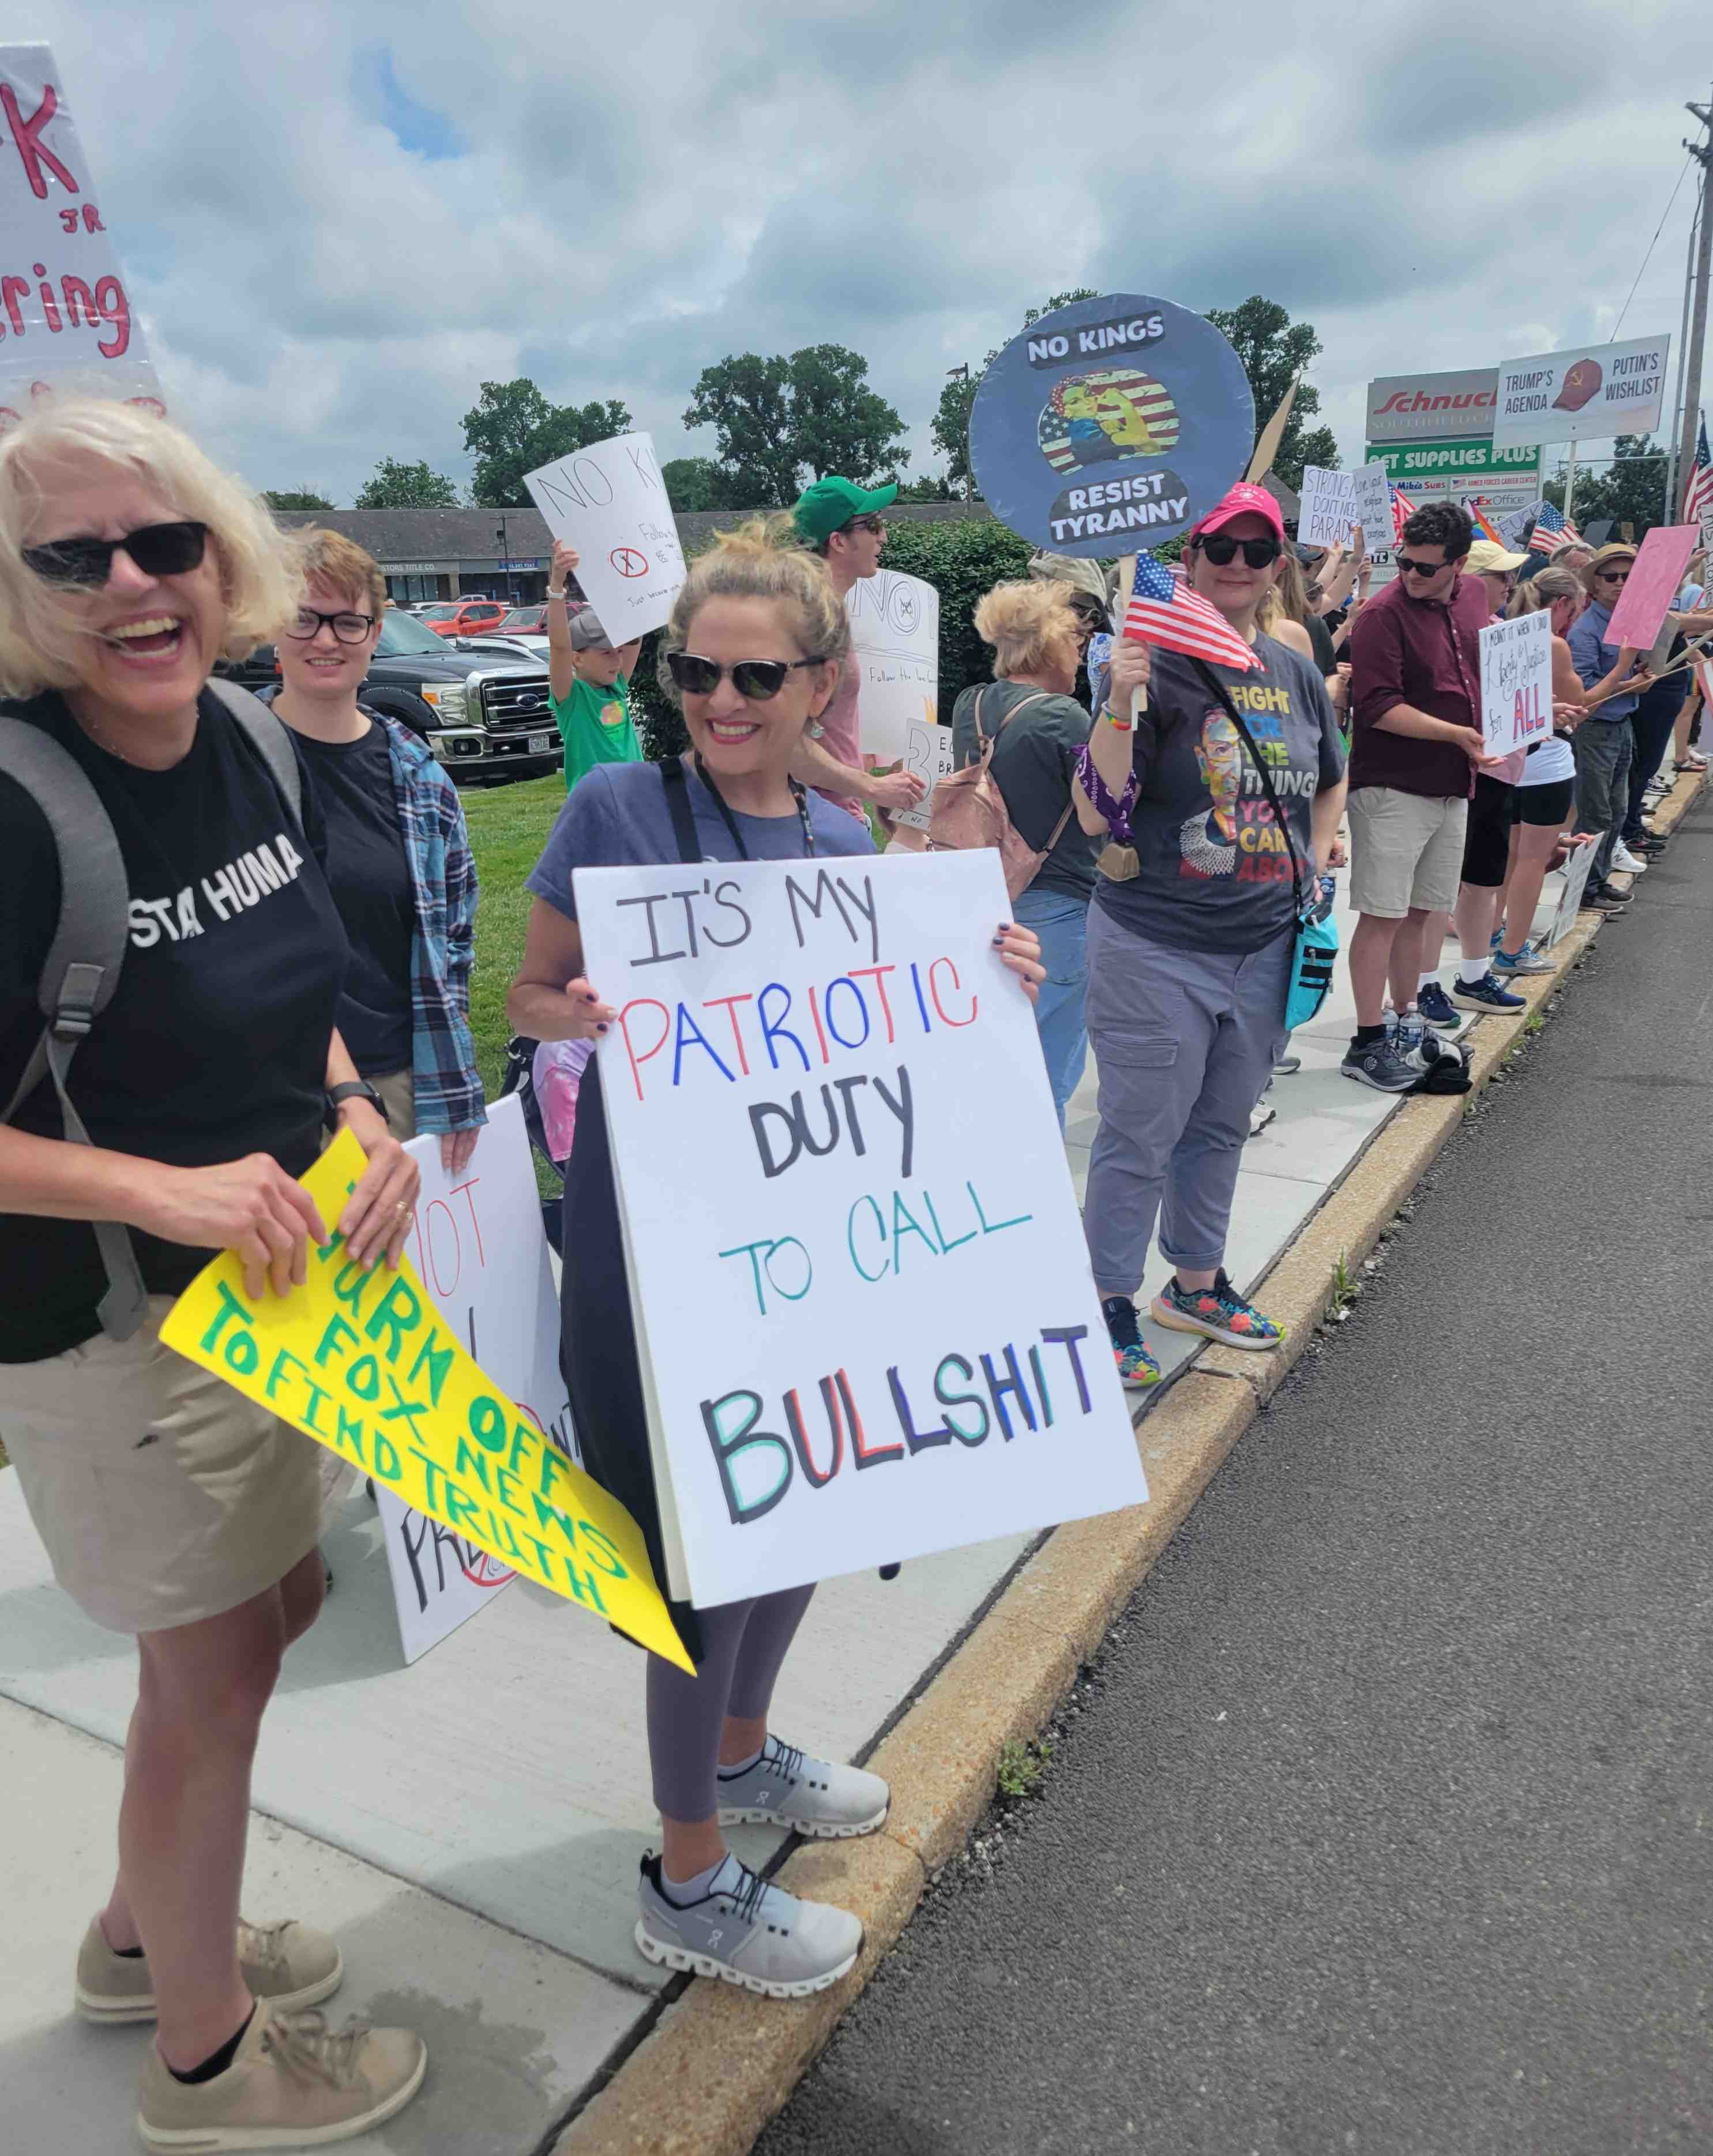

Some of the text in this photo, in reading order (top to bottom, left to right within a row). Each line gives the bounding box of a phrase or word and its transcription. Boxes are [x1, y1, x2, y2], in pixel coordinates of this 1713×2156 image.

[0, 84, 80, 199] K
[59, 204, 107, 233] JR
[0, 263, 130, 358] ring
[1028, 316, 1164, 362] NO KINGS
[1505, 370, 1554, 392] TRUMP'S
[1612, 353, 1659, 376] PUTIN'S
[1373, 391, 1498, 415] Schnuc
[1505, 393, 1547, 414] AGENDA
[1605, 376, 1661, 400] WISHLIST
[1404, 448, 1486, 470] SUPPLIES
[1491, 445, 1538, 463] PLUS
[536, 457, 613, 518] NO
[1068, 473, 1165, 511] RESIST
[1340, 501, 1357, 517] NEE
[1493, 494, 1525, 505] Office
[1050, 496, 1188, 541] TYRANNY
[405, 563, 424, 571] TITLE
[848, 571, 921, 636] NO
[1229, 686, 1290, 714] FIGHT
[1513, 683, 1546, 743] ALL
[1239, 827, 1294, 853] CAR
[127, 833, 305, 948] STA HUMA
[616, 868, 880, 967] IT'S MY
[618, 957, 979, 1101] PATRIOTIC
[748, 1064, 914, 1179] DUTY
[718, 1180, 1034, 1316] TO CALL
[198, 1279, 260, 1377] TO
[265, 1347, 404, 1482] FIND
[408, 1445, 609, 1615] TRUTH
[314, 1312, 430, 1447] FOX
[454, 1435, 629, 1580] NEWS
[468, 1395, 570, 1499] OFF
[698, 1324, 1093, 1525] BULLSHIT
